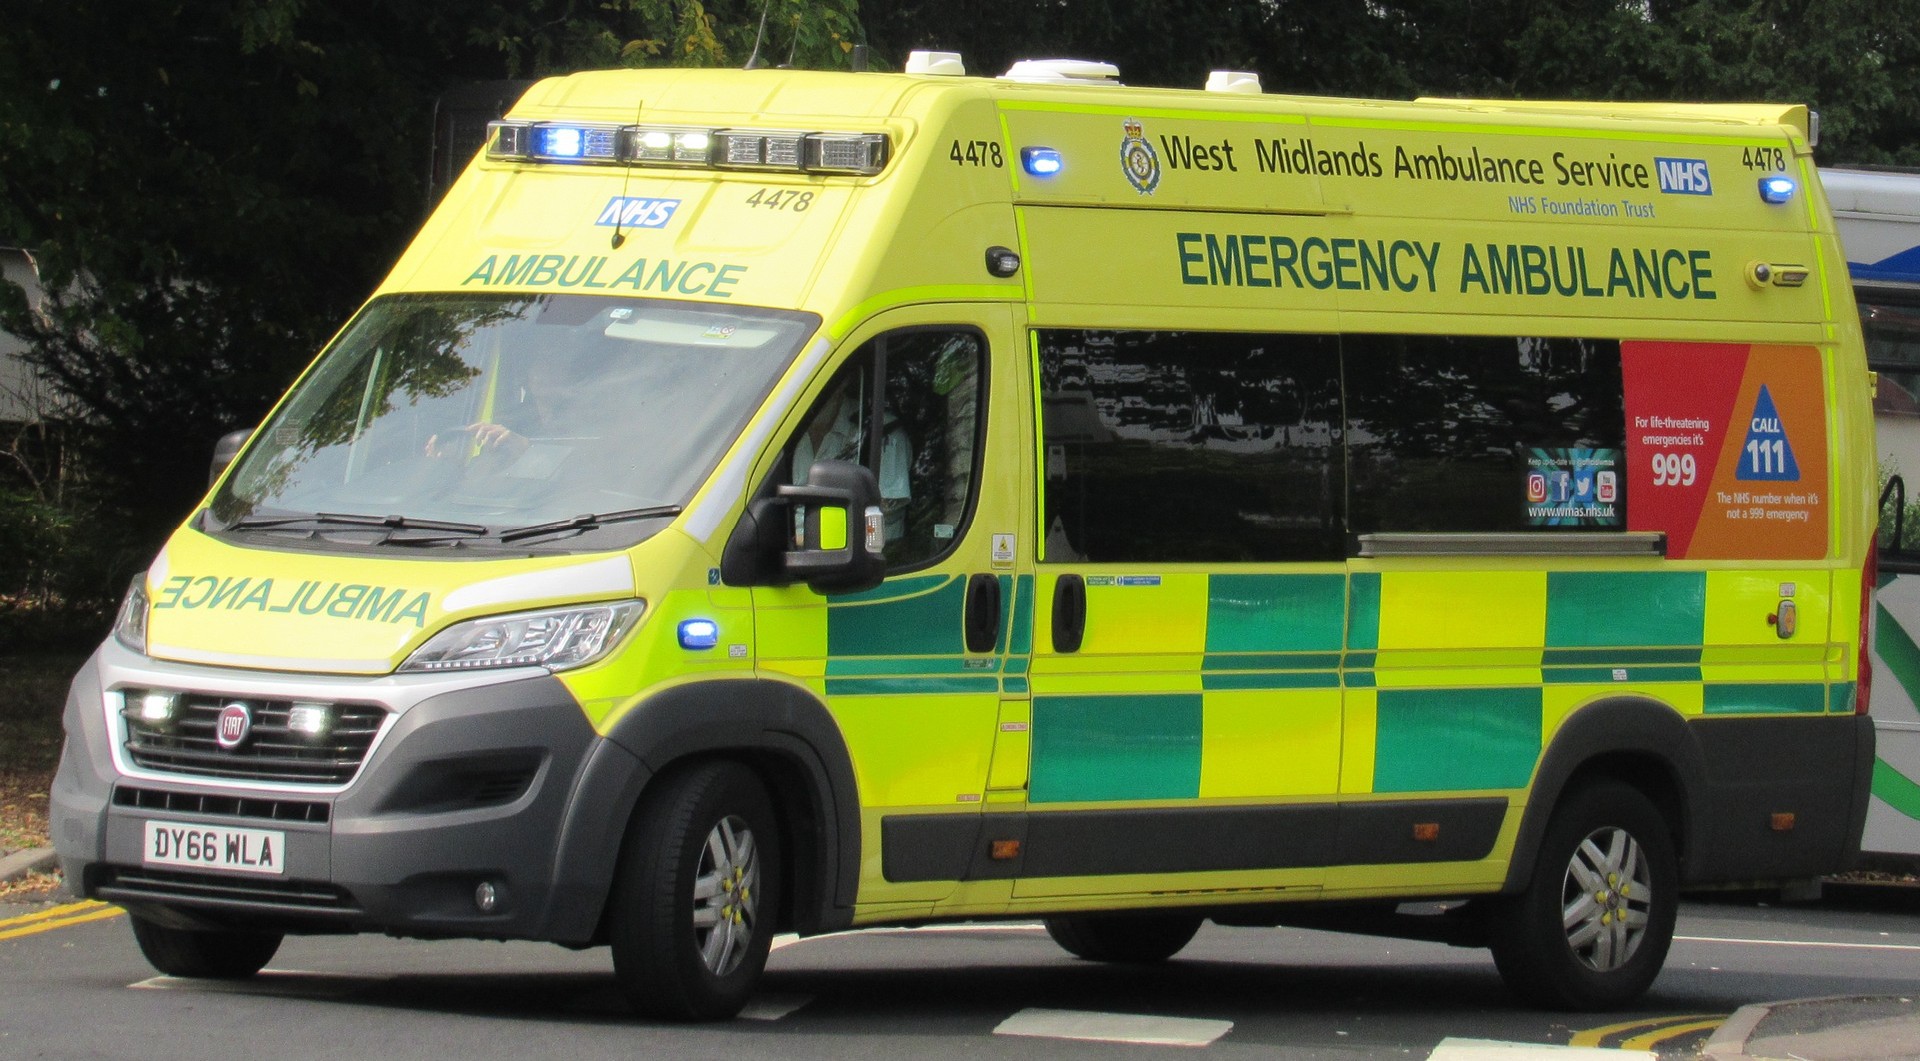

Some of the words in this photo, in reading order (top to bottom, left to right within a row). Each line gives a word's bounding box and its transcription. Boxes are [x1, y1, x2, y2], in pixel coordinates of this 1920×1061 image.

[950, 139, 1003, 168] 4478
[1160, 134, 1238, 172] West
[1253, 137, 1383, 177] Midlands
[1394, 144, 1545, 185] Ambulance
[1552, 151, 1650, 189] Service
[1742, 147, 1786, 172] 4478
[1657, 160, 1709, 193] NHS
[597, 198, 679, 226] NHS
[745, 188, 814, 213] 4478
[1508, 196, 1537, 214] NHS
[1541, 197, 1619, 217] Foundation
[1621, 200, 1656, 218] Trust
[461, 254, 748, 298] AMBULANCE
[1176, 232, 1441, 293] EMERGENCY
[1459, 242, 1718, 301] AMBULANCE
[1635, 416, 1649, 428] For
[1650, 415, 1710, 432] life-threatening
[1751, 417, 1780, 433] CALL
[1642, 433, 1692, 448] emergencies
[1693, 433, 1704, 445] it's
[1746, 440, 1784, 473] 111
[1652, 453, 1697, 487] 999
[1528, 504, 1615, 518] www.wmas.nhs.uk
[1717, 492, 1732, 504] The
[1734, 492, 1750, 504] NHS
[1752, 492, 1782, 505] number
[1784, 493, 1806, 505] when
[1808, 493, 1819, 505] it's
[1727, 508, 1741, 519] not
[1742, 510, 1748, 519] a
[1749, 508, 1764, 519] 999
[1766, 510, 1809, 522] emergency
[223, 716, 244, 736] FIAT
[154, 827, 217, 862] DY66
[225, 833, 274, 867] WLA
